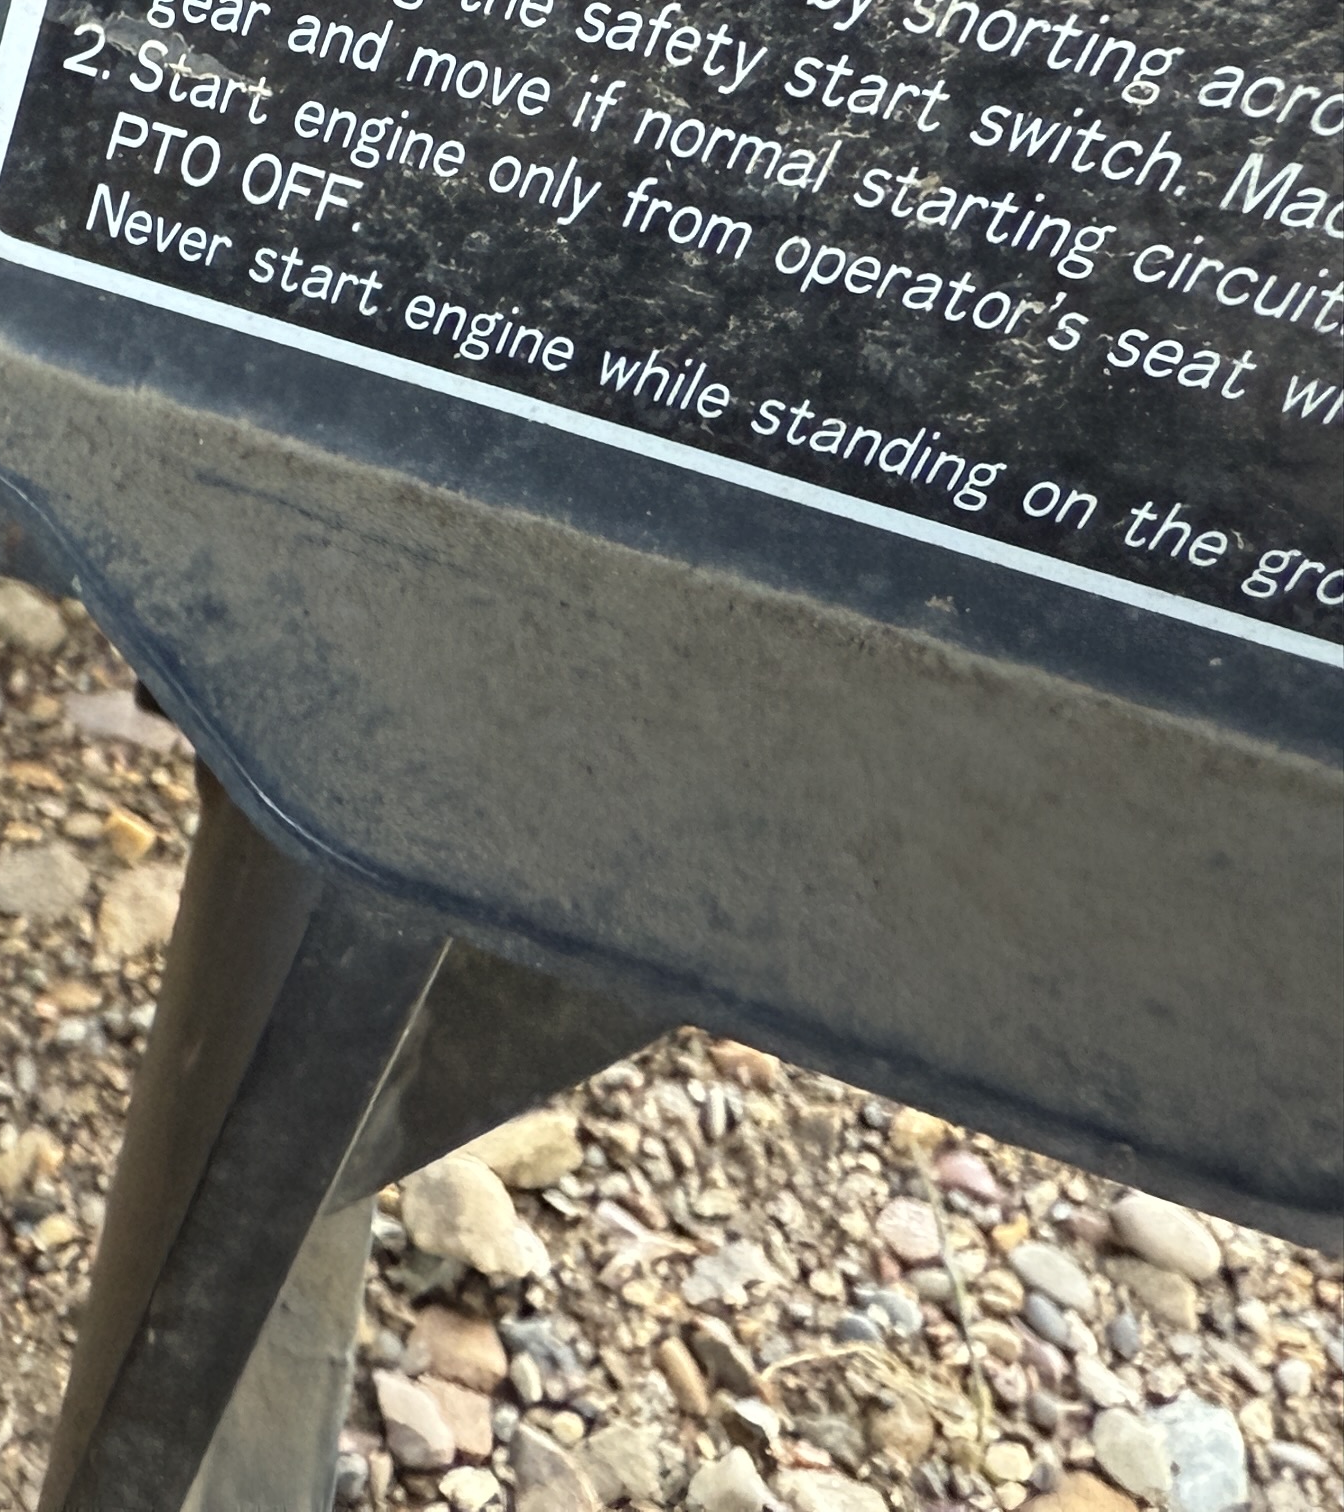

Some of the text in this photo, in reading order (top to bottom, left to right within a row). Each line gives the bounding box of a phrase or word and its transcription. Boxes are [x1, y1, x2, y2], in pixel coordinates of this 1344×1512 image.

[62, 23, 111, 80] 2.
[129, 39, 273, 125] Start
[293, 100, 466, 178] engine
[488, 155, 602, 226] only
[622, 177, 752, 260] from
[775, 232, 1089, 352] operator's
[1106, 328, 1257, 401] seat
[105, 111, 364, 233] PTO OFF.
[287, 13, 394, 72] and
[406, 46, 552, 116] move
[572, 76, 626, 133] if
[633, 108, 842, 194] normal
[854, 164, 1117, 279] starting
[575, 0, 768, 95] safety
[784, 53, 951, 134] start
[969, 103, 1188, 198] switch.
[86, 183, 234, 267] Never
[248, 244, 384, 318] start
[404, 293, 576, 373] engine
[600, 349, 731, 420] while
[750, 399, 1008, 512] standing
[1022, 478, 1100, 531] on
[1120, 500, 1229, 568] the
